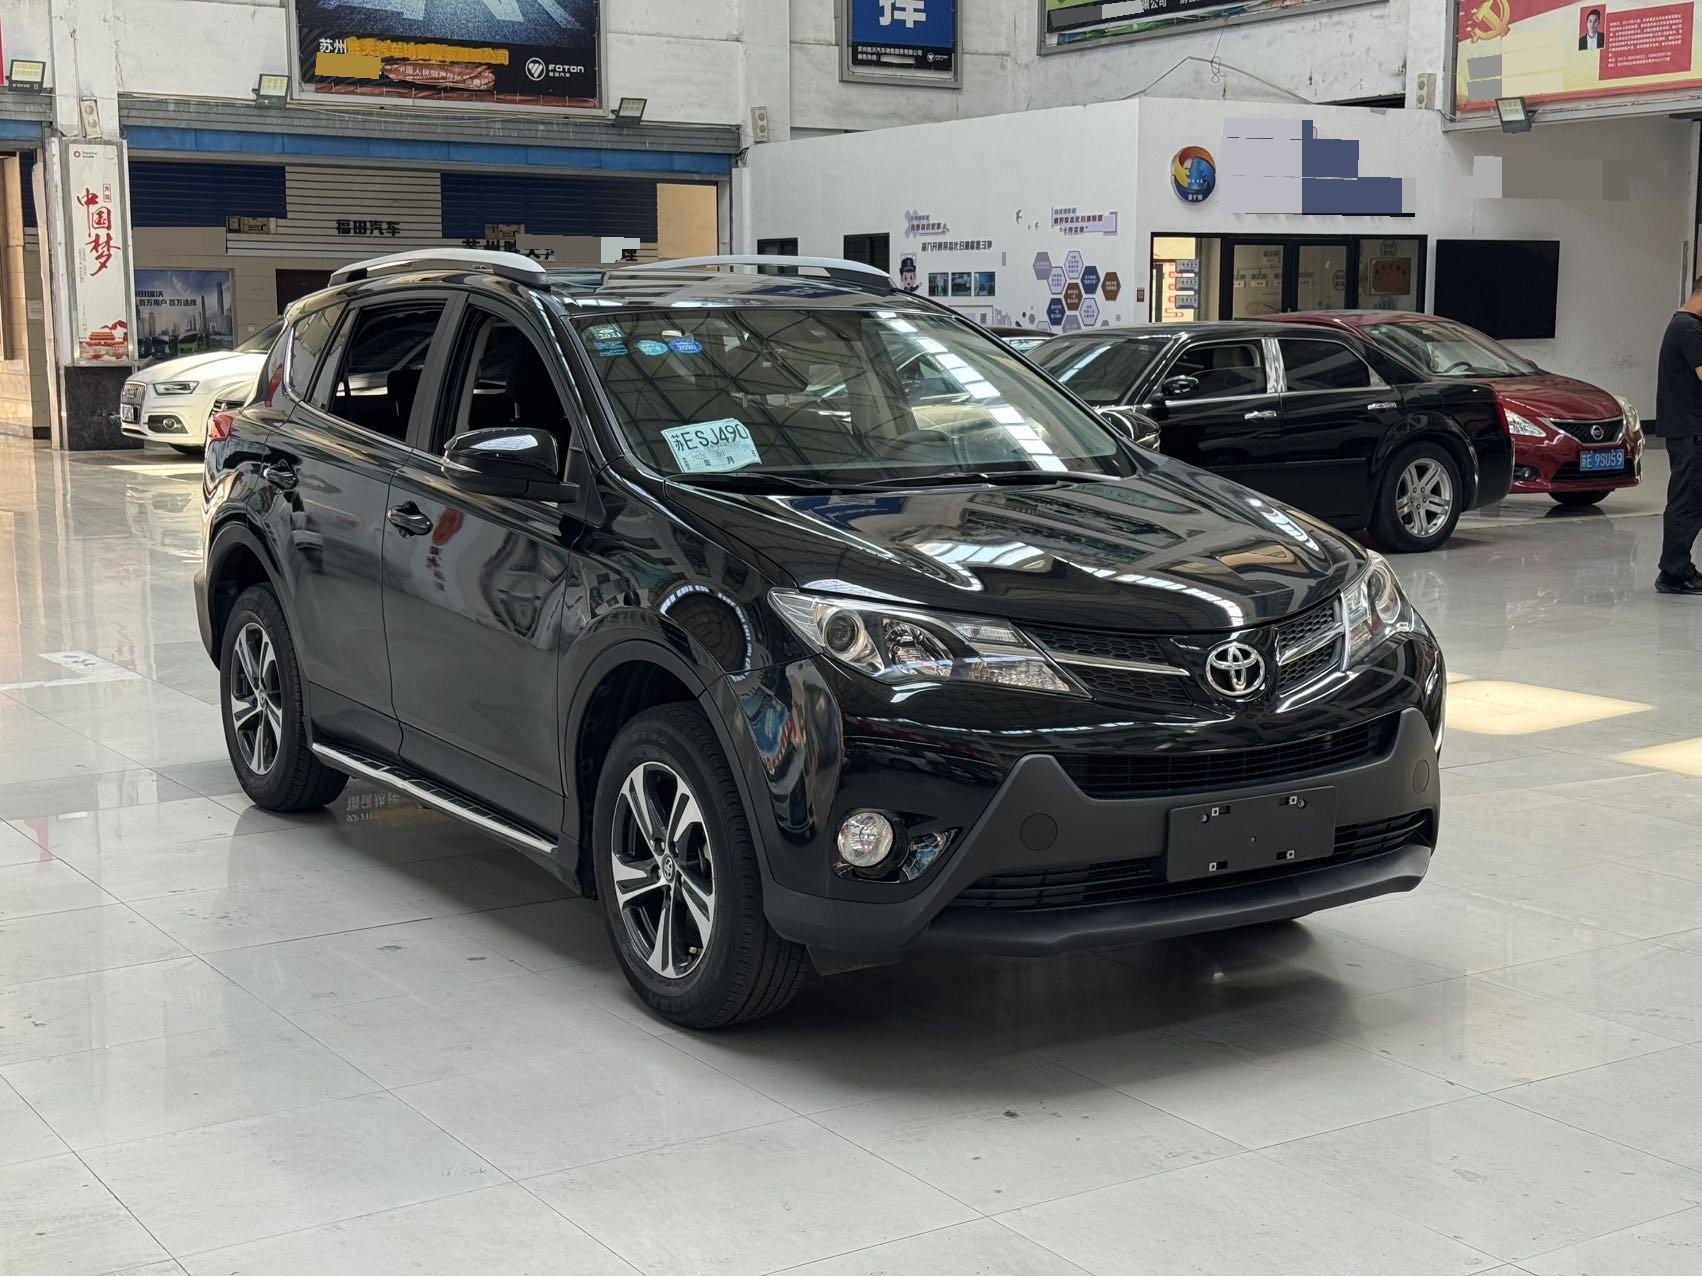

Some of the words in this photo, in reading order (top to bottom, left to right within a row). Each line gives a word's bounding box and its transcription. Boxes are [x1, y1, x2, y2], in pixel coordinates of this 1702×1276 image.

[548, 63, 585, 73] FOTON
[76, 187, 121, 276] 中国梦
[336, 219, 401, 237] 福田汽车
[135, 290, 164, 298] 田瑞沃
